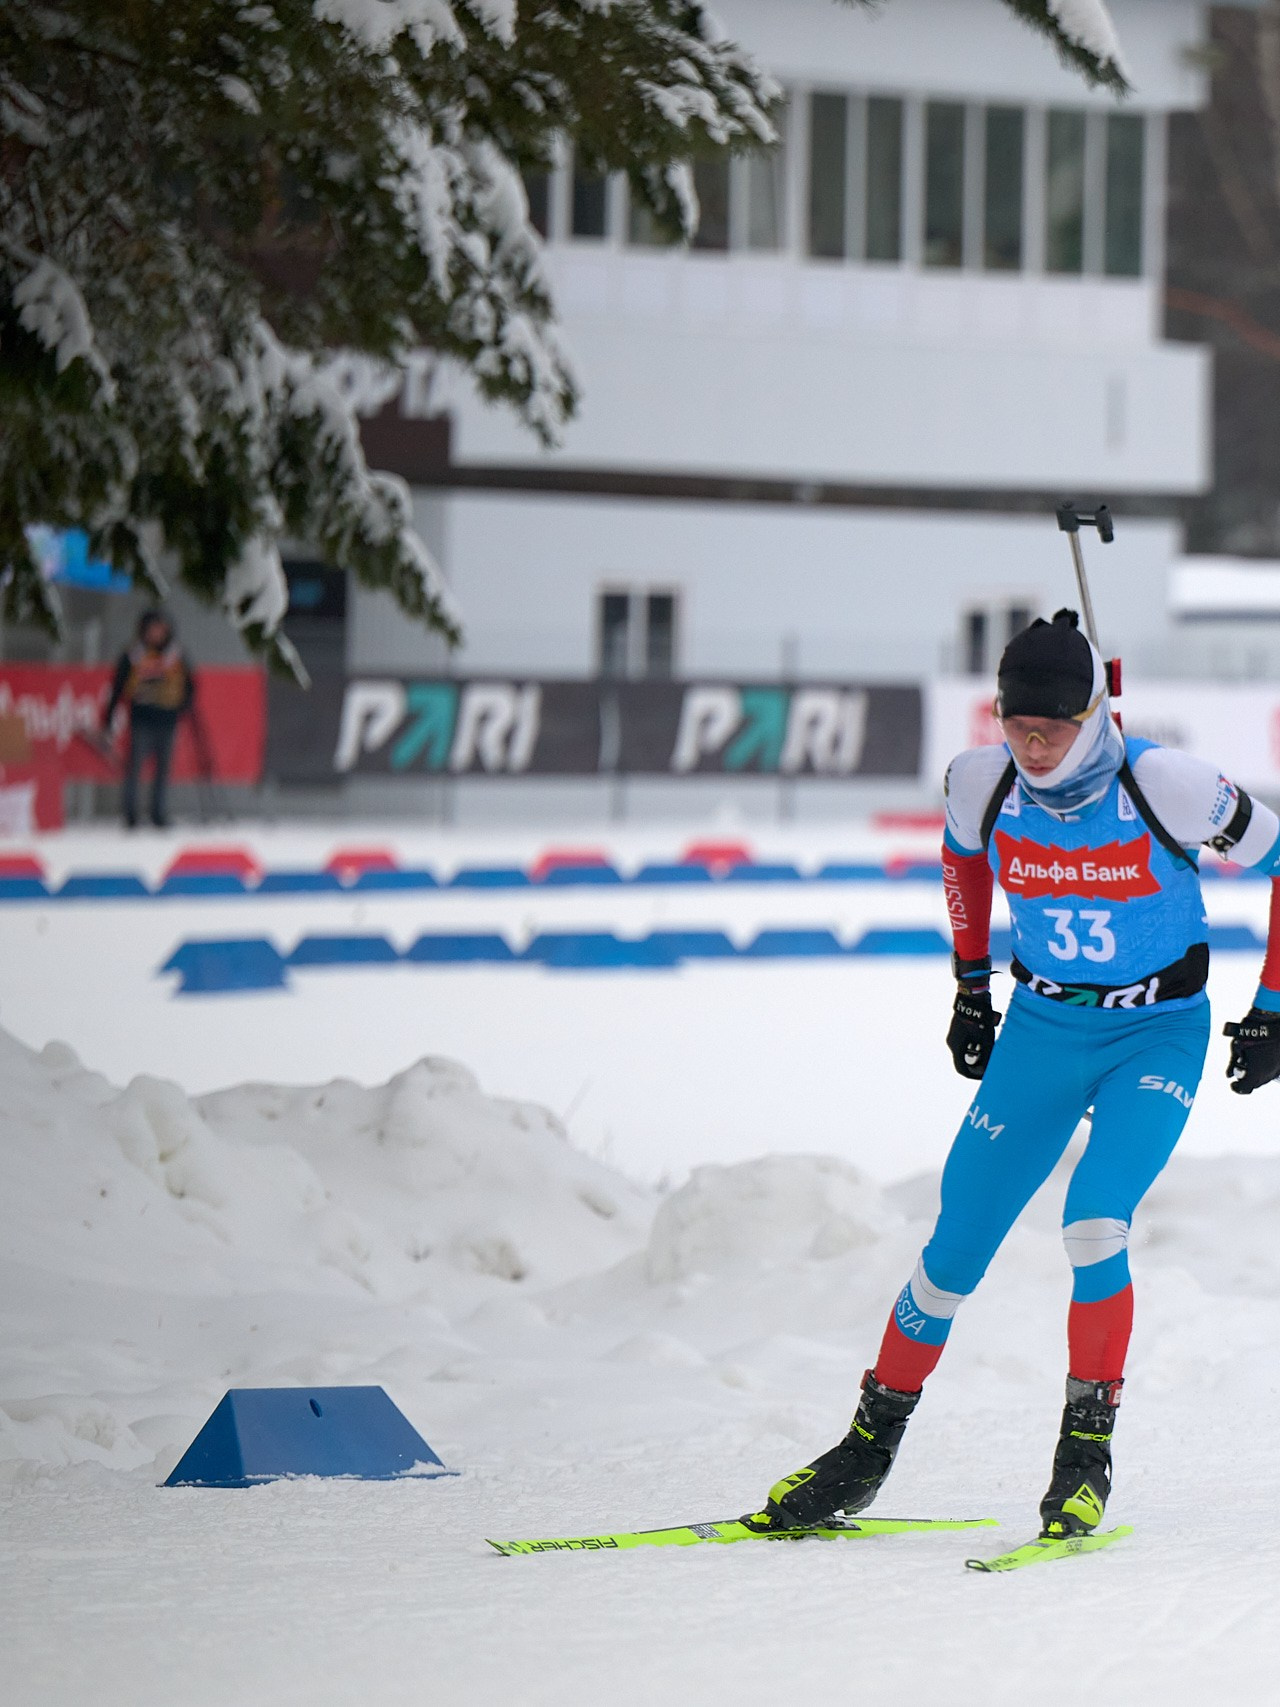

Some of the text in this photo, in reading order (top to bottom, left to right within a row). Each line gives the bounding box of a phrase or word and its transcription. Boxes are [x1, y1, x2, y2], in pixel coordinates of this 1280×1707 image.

[334, 680, 541, 772] PARI
[670, 685, 868, 772] PARI
[1008, 857, 1140, 885] Альфа Банк
[942, 863, 969, 931] RUSSIA
[1042, 908, 1117, 963] 33
[1026, 974, 1161, 1009] PARI
[1239, 1028, 1268, 1037] MOAX
[529, 1536, 618, 1552] FISCHER
